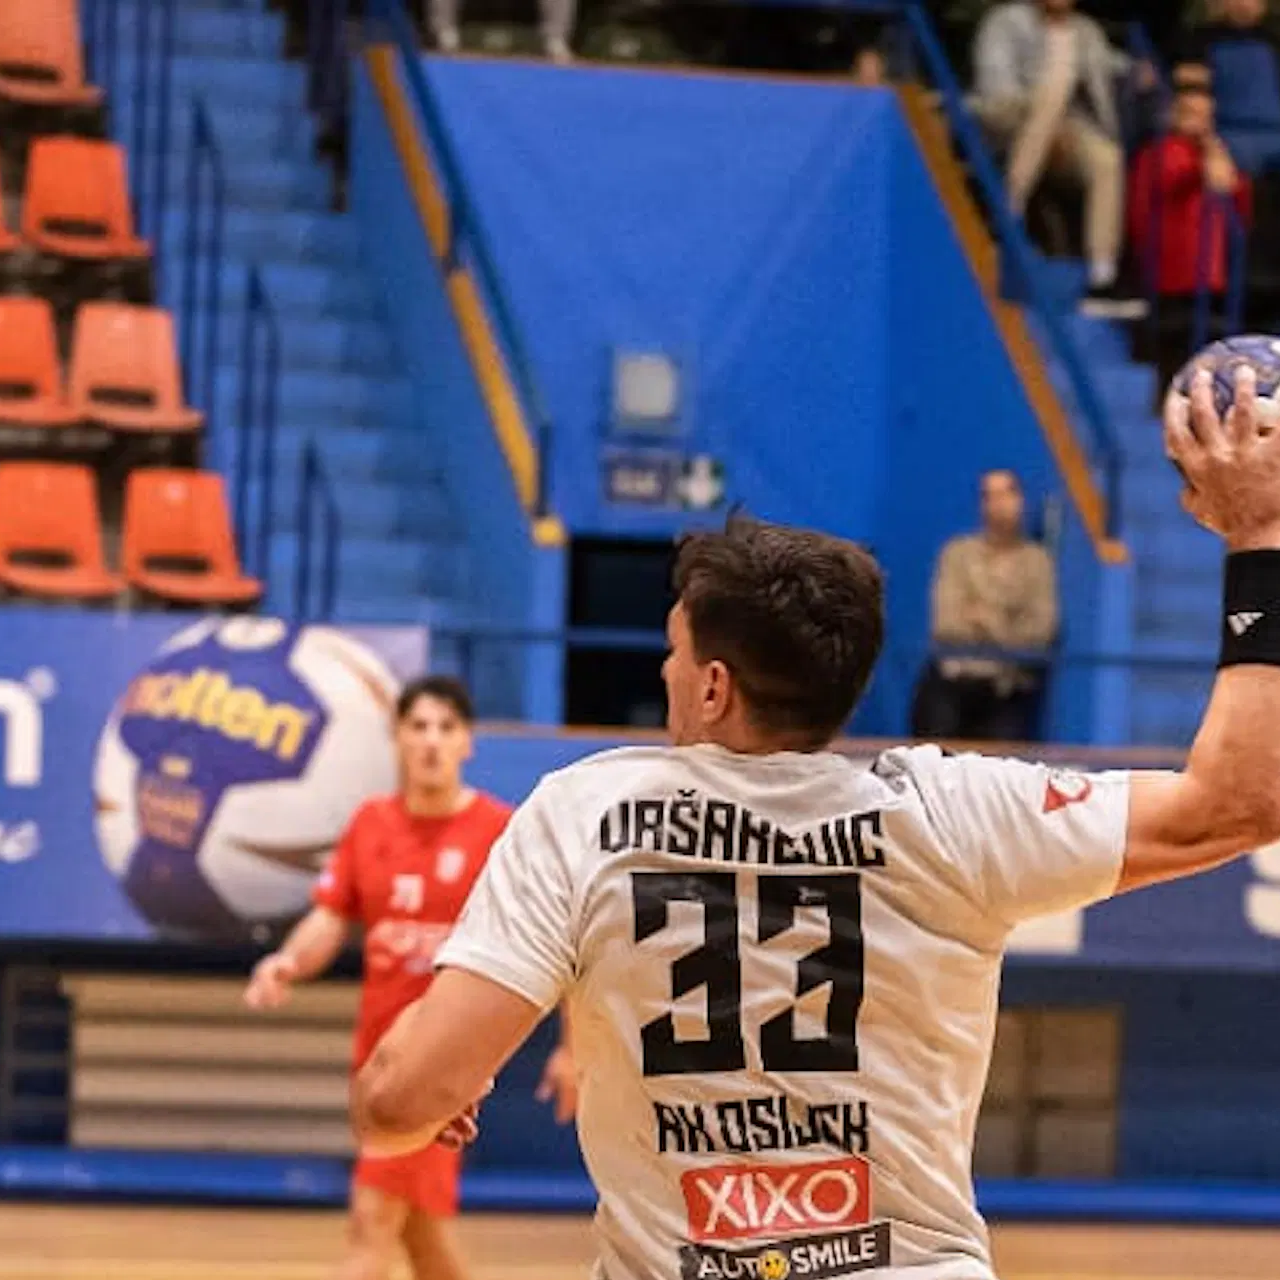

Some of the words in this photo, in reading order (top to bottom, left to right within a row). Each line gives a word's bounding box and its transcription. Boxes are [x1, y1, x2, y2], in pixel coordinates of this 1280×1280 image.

[631, 871, 865, 1076] 33
[695, 1169, 859, 1234] XIXO
[790, 1232, 878, 1276] SMILE
